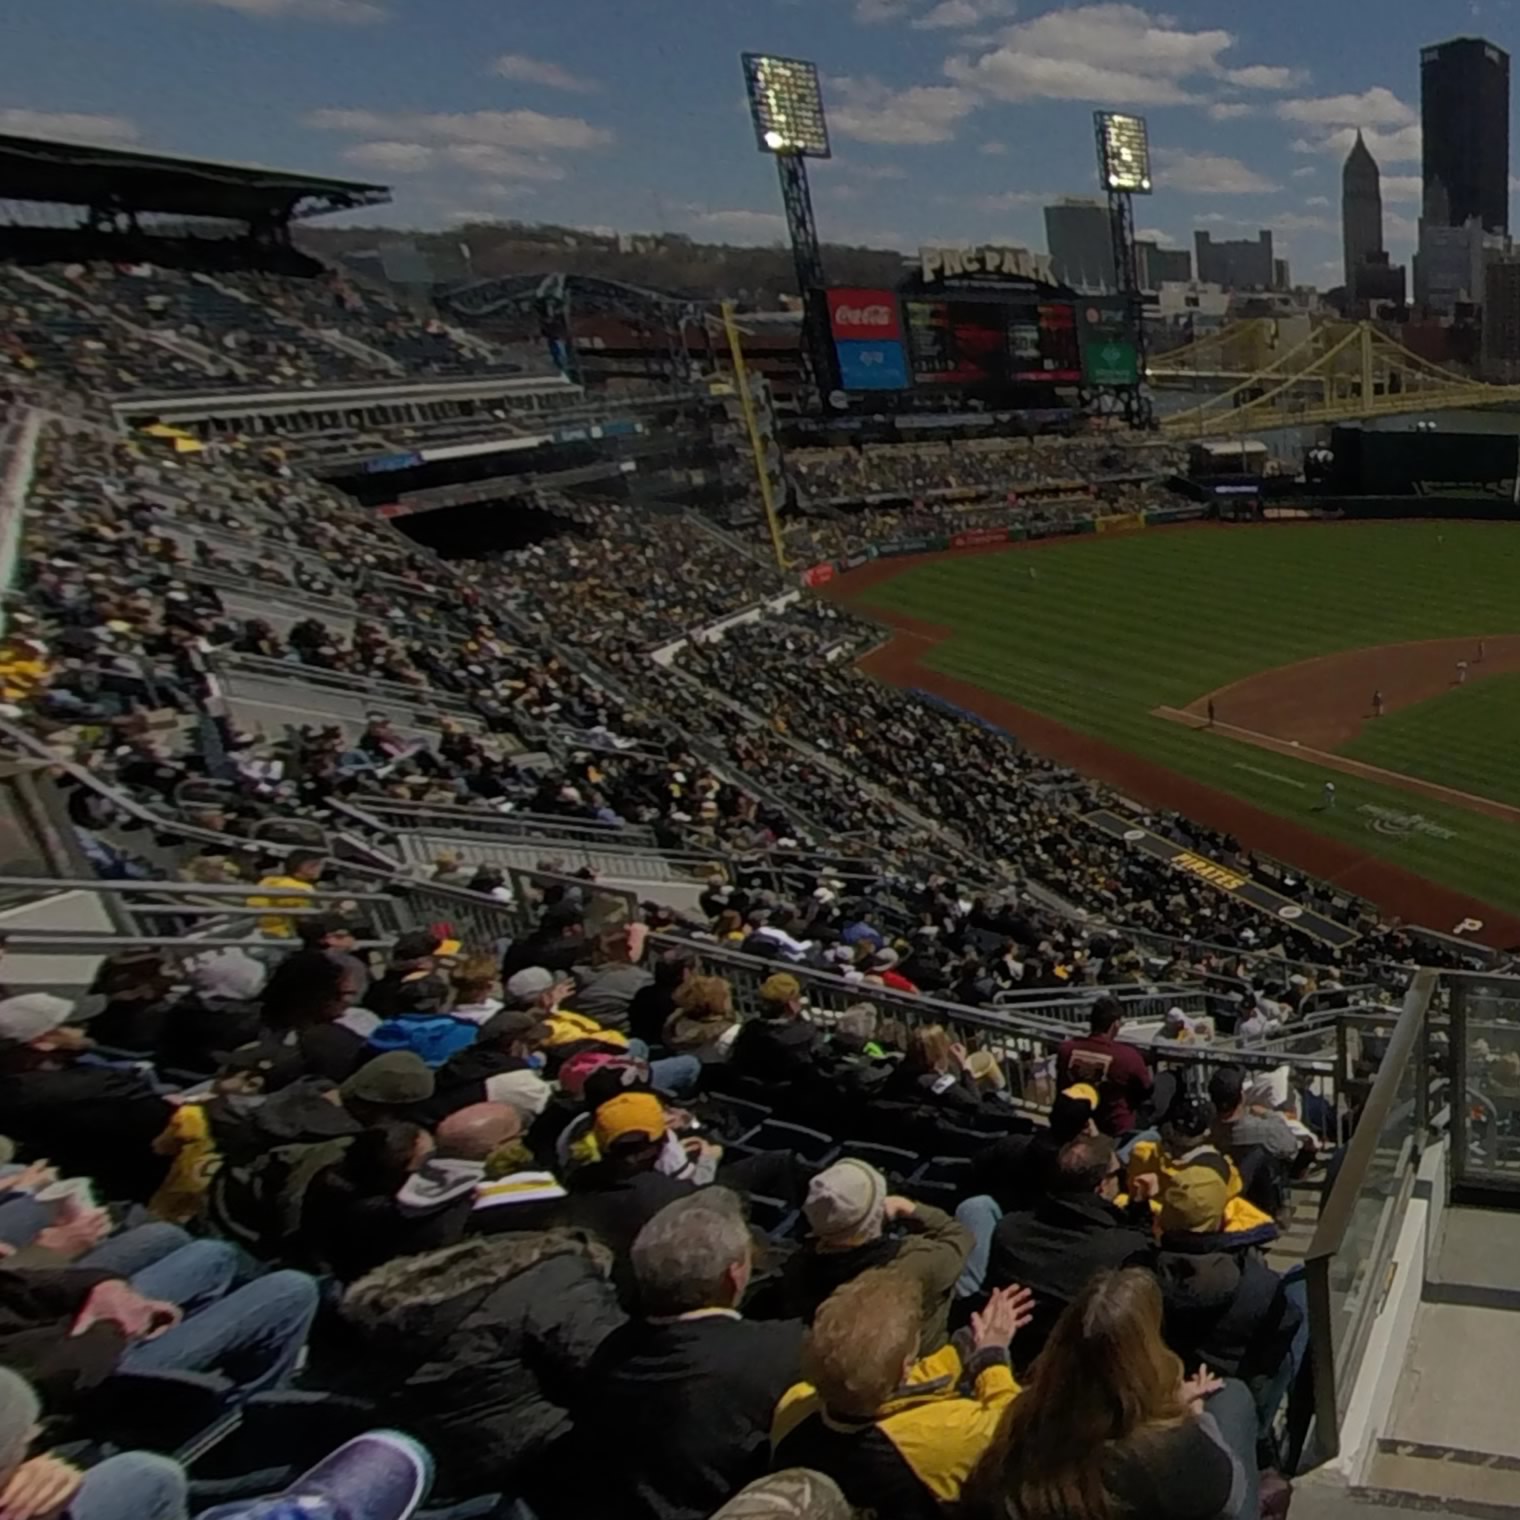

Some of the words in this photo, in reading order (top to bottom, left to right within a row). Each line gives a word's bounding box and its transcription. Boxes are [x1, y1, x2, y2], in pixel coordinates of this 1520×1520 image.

[919, 246, 981, 283] PNC
[984, 249, 1059, 289] PARK
[1170, 852, 1246, 890] PIRATES
[1453, 917, 1484, 935] P
